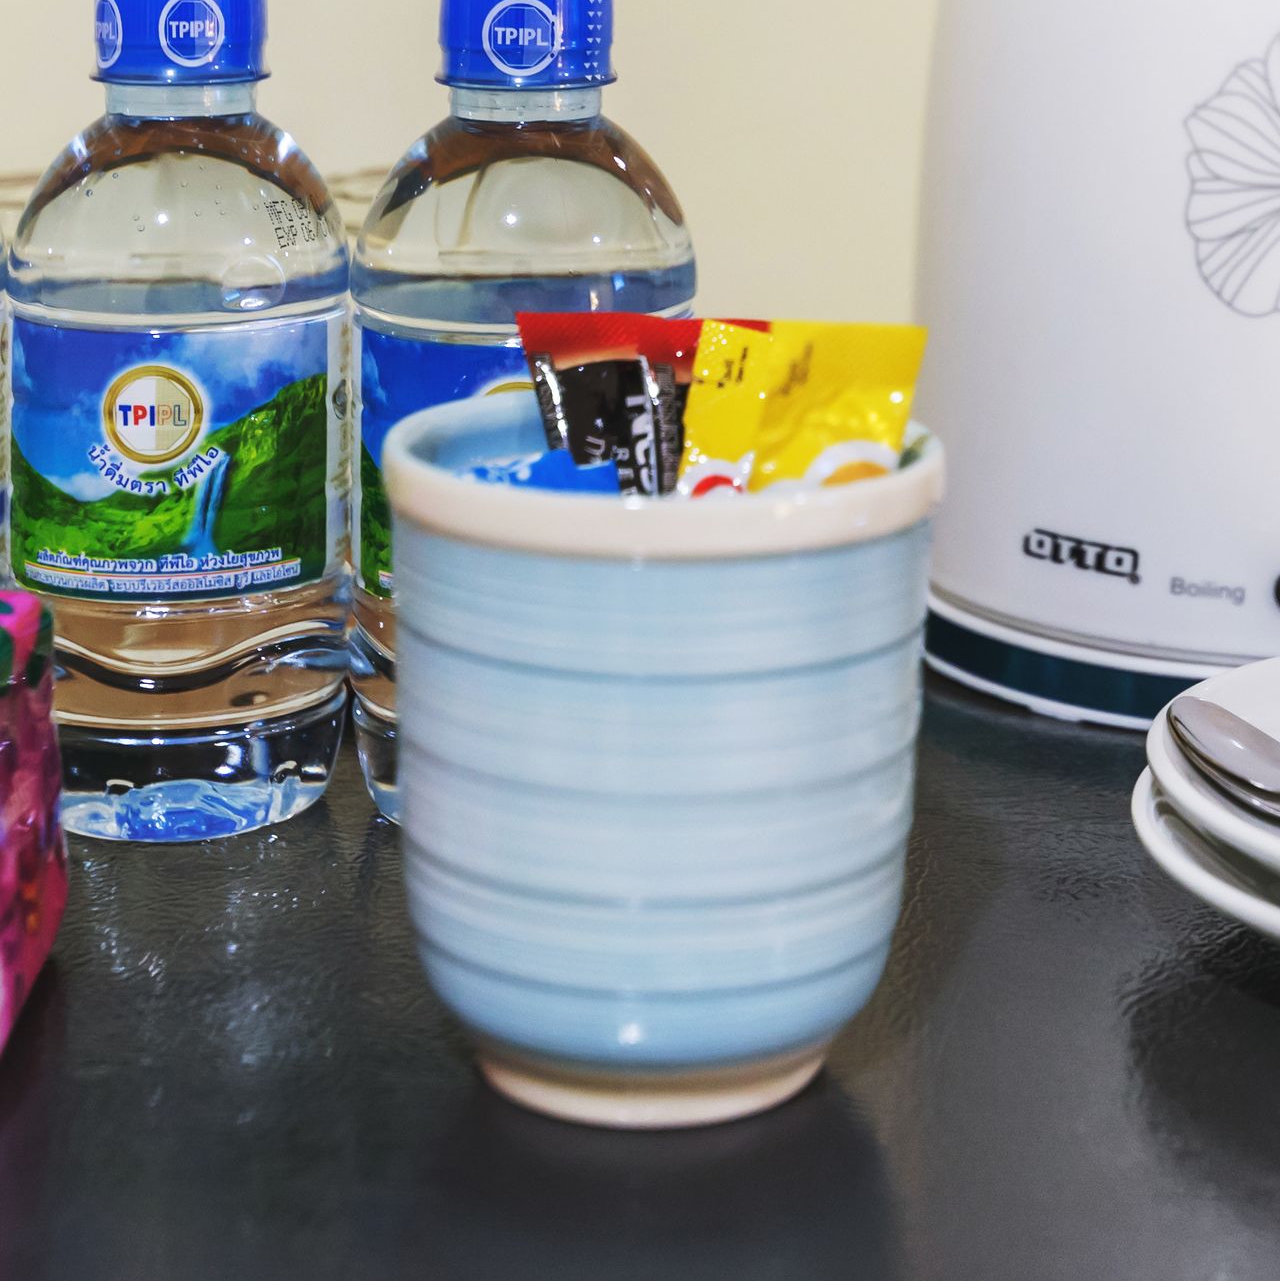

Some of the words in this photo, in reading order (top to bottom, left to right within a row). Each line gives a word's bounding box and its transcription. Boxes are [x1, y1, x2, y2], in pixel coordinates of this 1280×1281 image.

[169, 20, 215, 38] TPIPL
[494, 27, 549, 46] TPIPL
[118, 405, 187, 426] TPIPL
[1023, 528, 1139, 579] OTTO
[1170, 576, 1246, 606] Boiling
